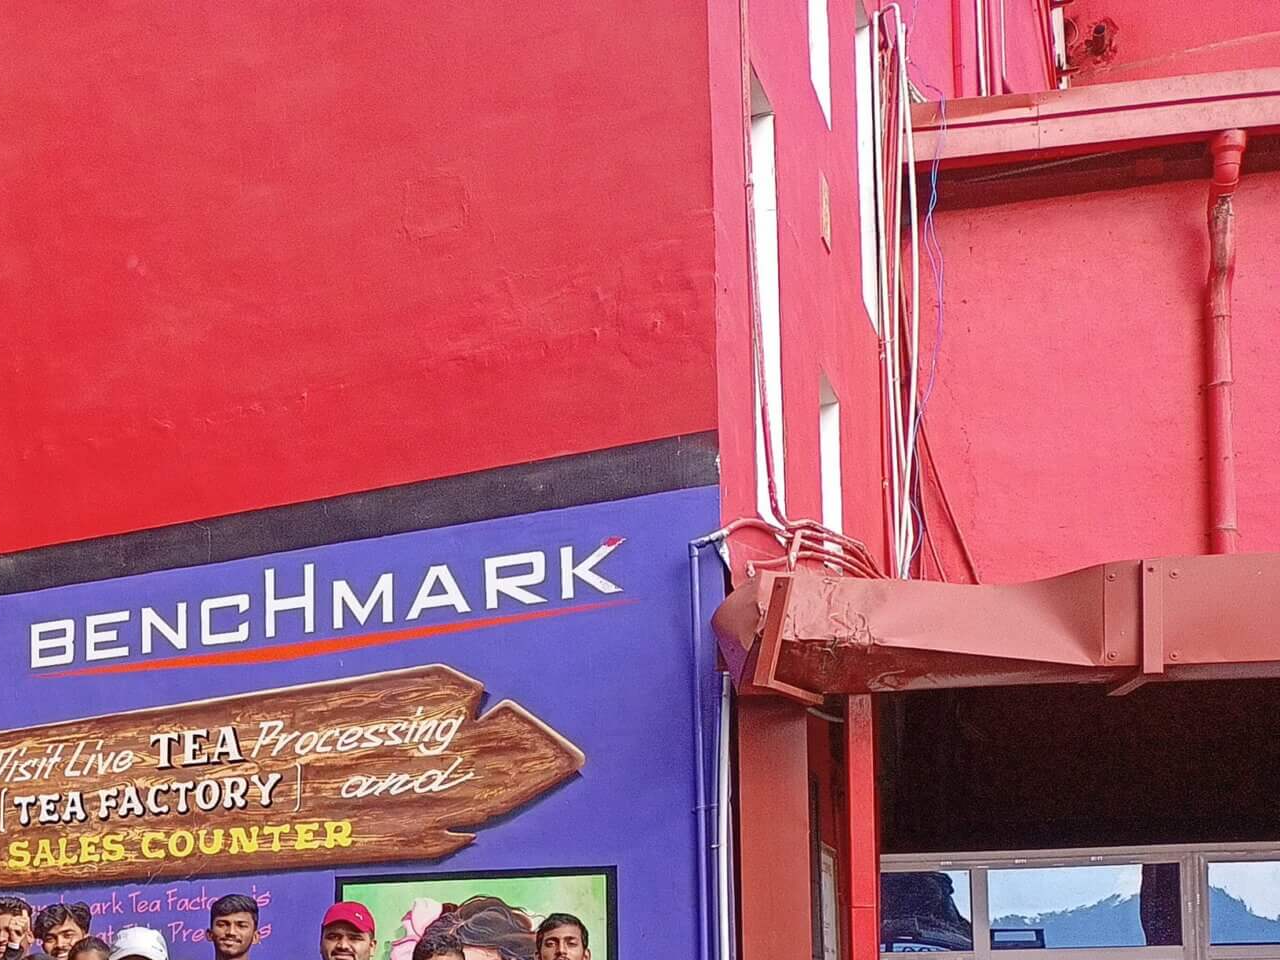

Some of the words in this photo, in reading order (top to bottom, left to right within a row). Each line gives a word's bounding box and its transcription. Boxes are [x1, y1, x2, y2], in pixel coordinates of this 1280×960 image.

[30, 537, 625, 669] BENCHMARK
[64, 740, 134, 778] Live
[150, 726, 243, 770] TEA
[251, 706, 467, 758] Processing
[340, 757, 475, 799] and
[7, 832, 126, 870] SALES
[140, 819, 354, 860] COUNTER
[128, 890, 161, 914] Tea
[166, 886, 220, 911] Facto
